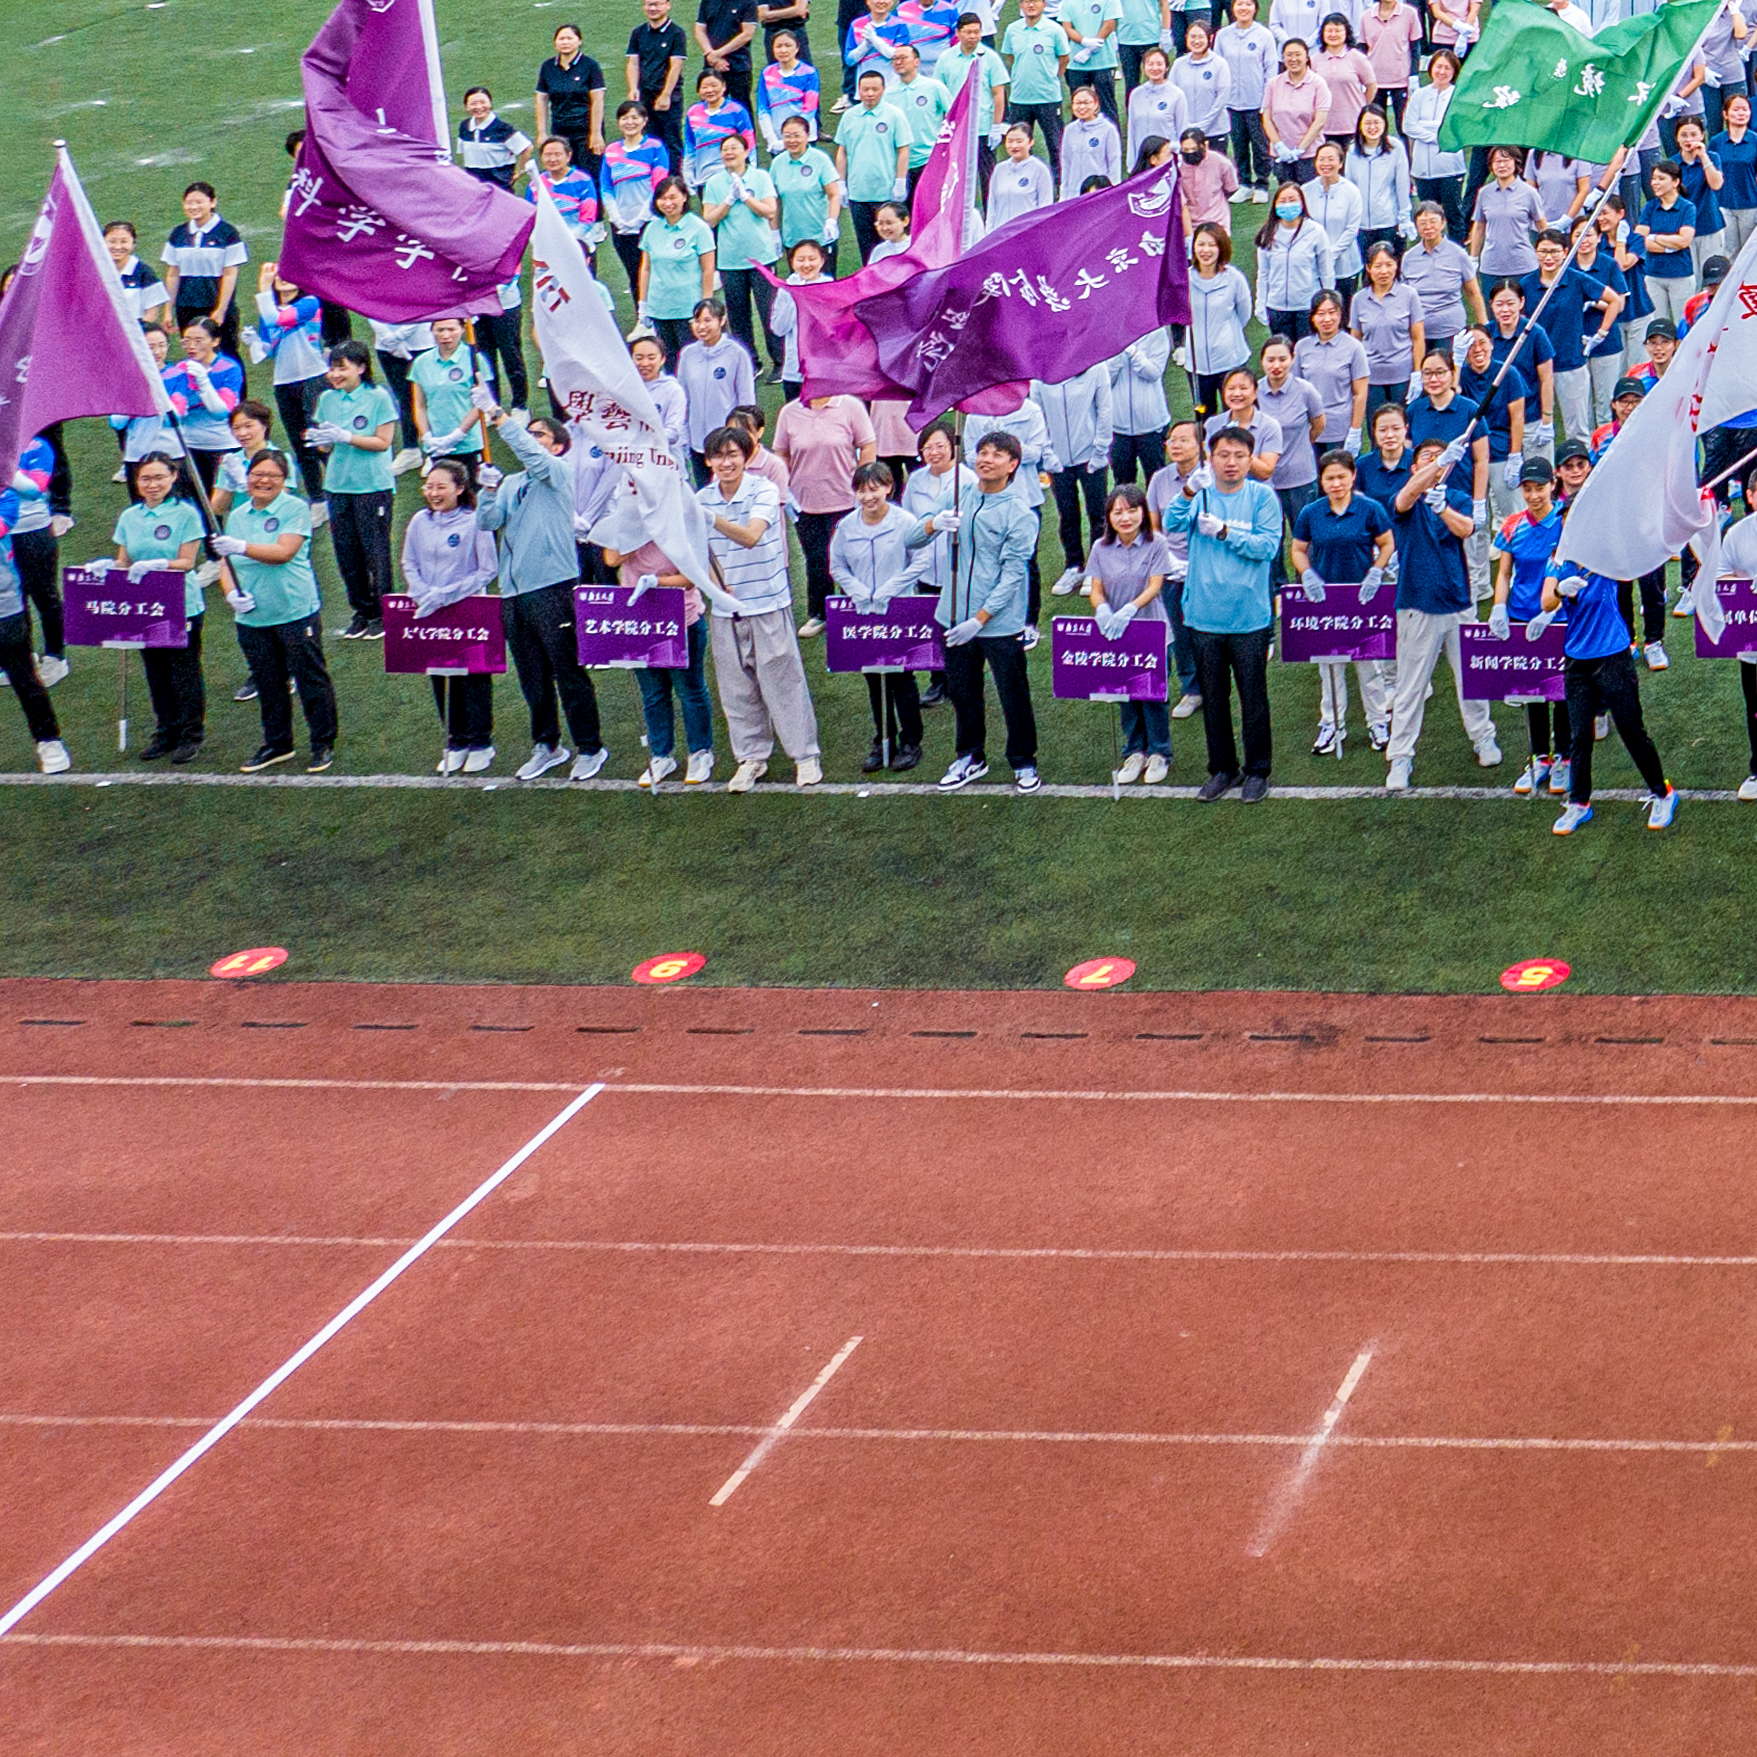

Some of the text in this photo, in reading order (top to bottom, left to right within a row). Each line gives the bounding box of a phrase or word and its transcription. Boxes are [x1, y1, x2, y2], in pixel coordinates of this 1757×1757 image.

[585, 618, 679, 637] 艺术学院分工会
[221, 955, 274, 973] 11
[1079, 965, 1114, 985] 7
[1517, 966, 1554, 986] 5
